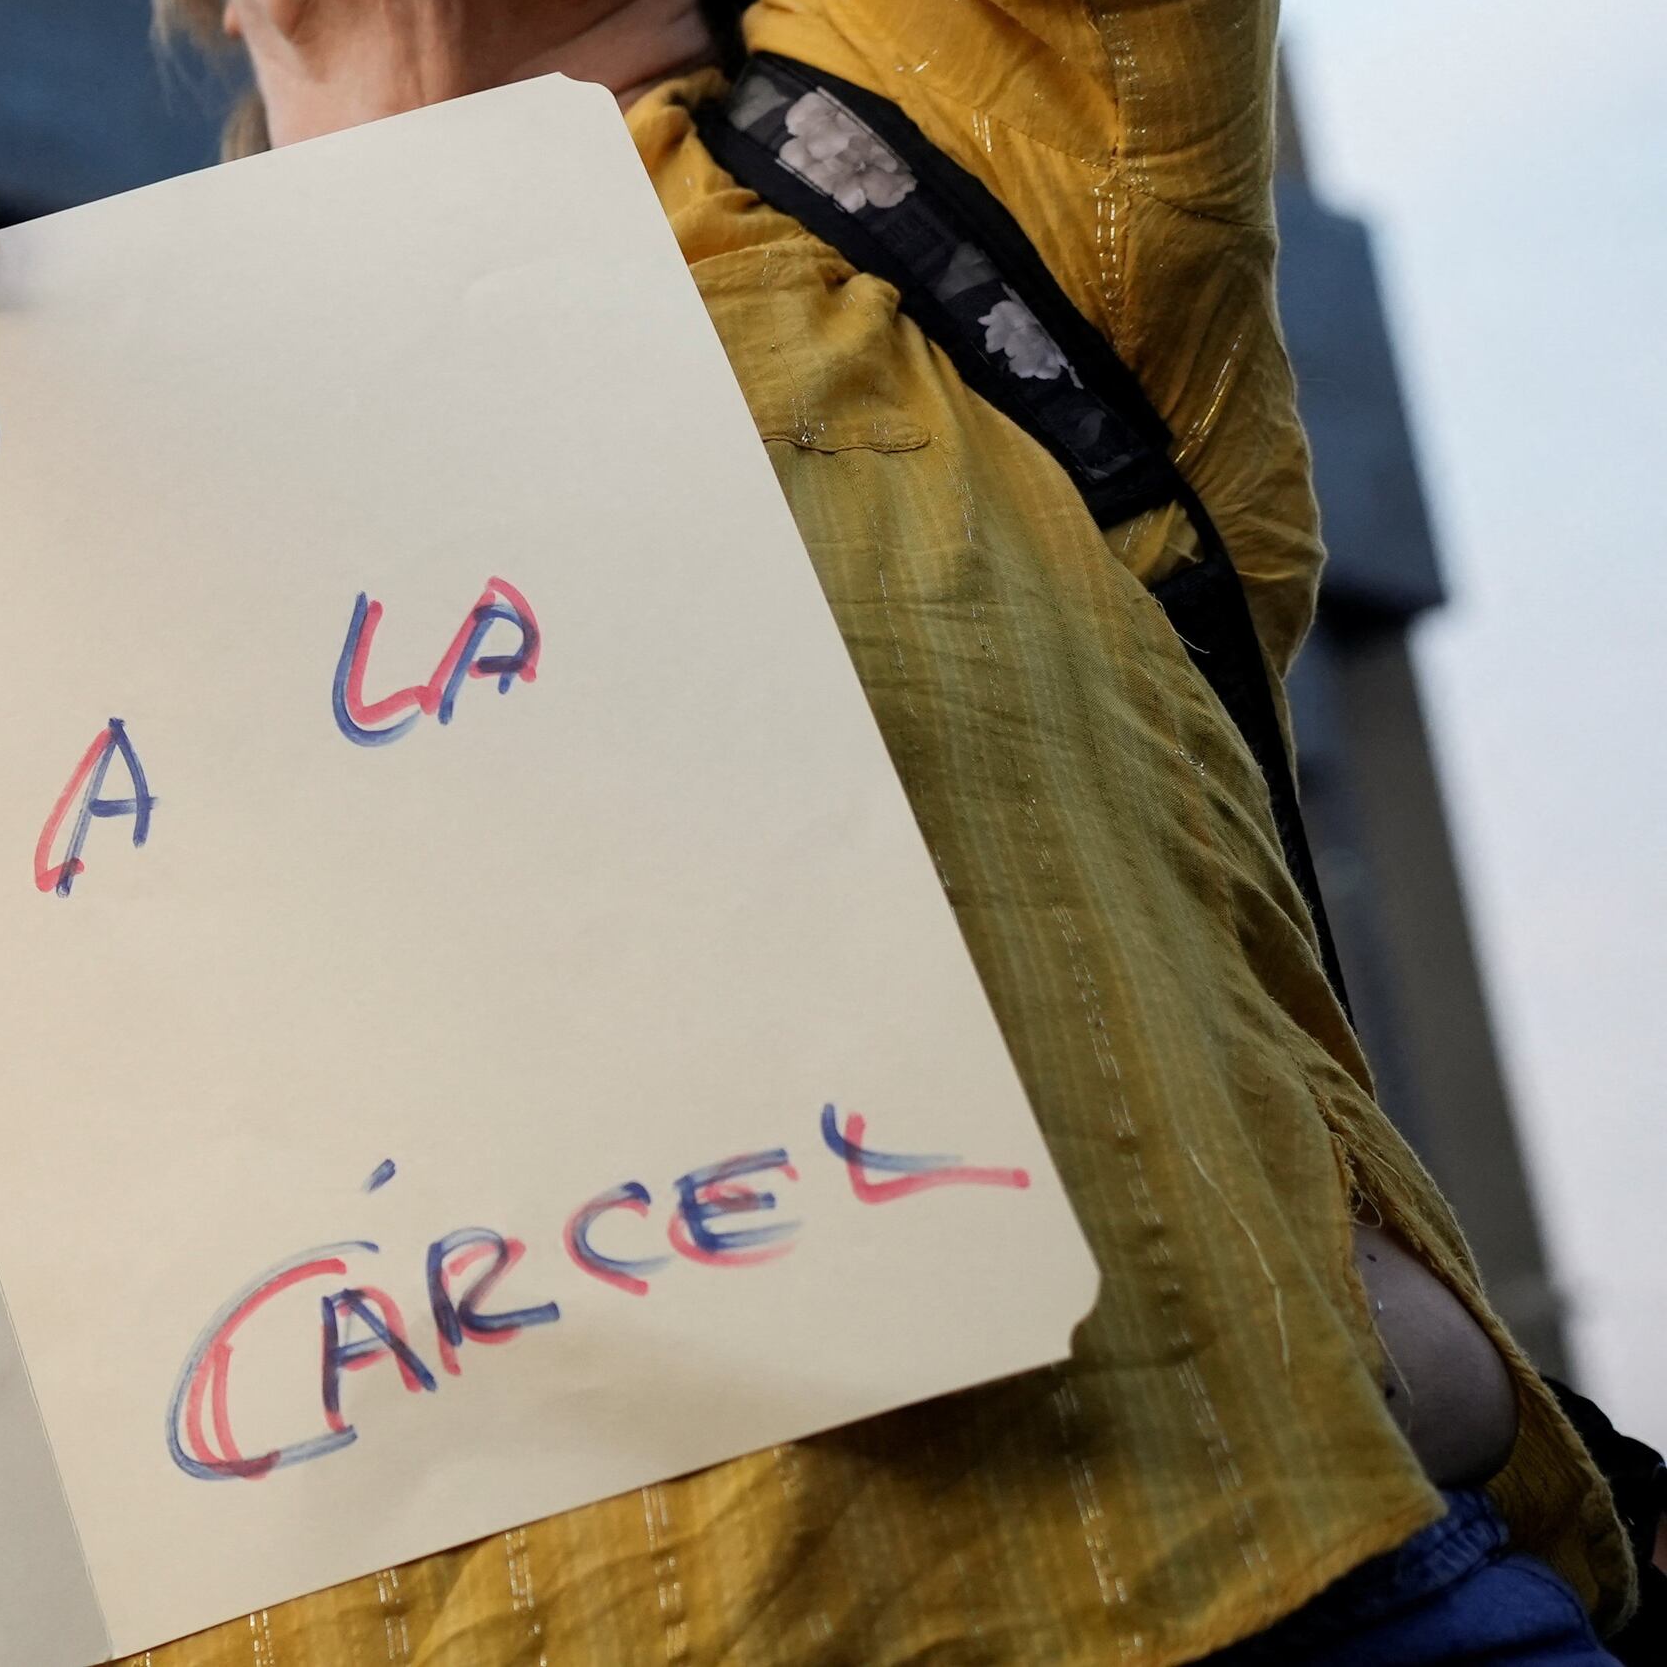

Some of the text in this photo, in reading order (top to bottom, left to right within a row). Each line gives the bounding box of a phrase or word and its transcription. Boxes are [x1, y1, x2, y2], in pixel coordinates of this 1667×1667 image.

[33, 576, 540, 897] A LA
[166, 1103, 1031, 1479] CÁRCEL
